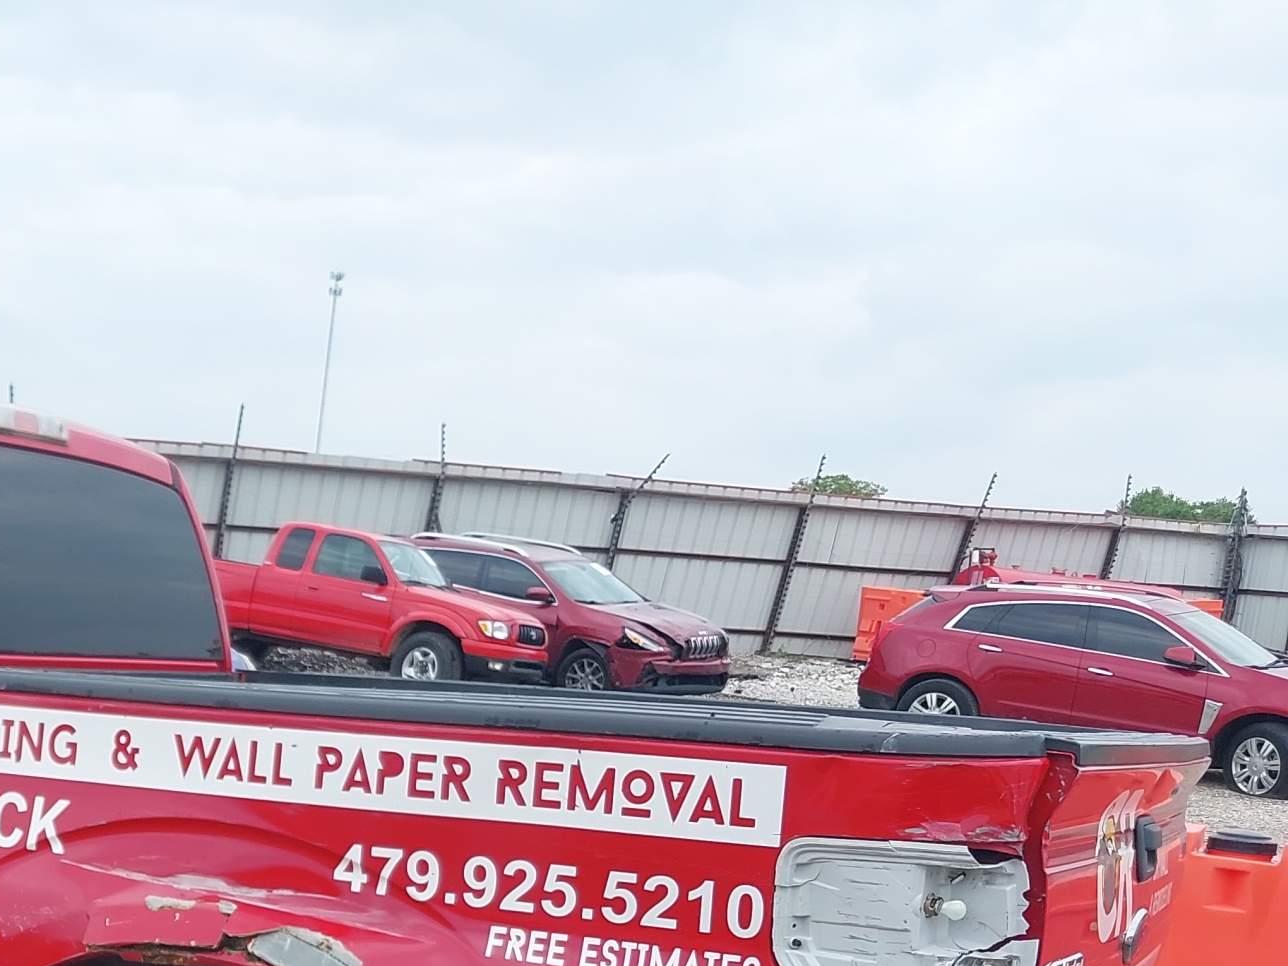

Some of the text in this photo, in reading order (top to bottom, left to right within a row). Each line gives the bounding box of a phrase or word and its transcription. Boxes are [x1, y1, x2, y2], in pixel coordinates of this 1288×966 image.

[110, 728, 141, 771] &
[174, 734, 293, 787] WALL
[314, 744, 472, 804] PAPER
[495, 756, 757, 828] REMOVAL
[332, 842, 765, 940] 479.925.5210
